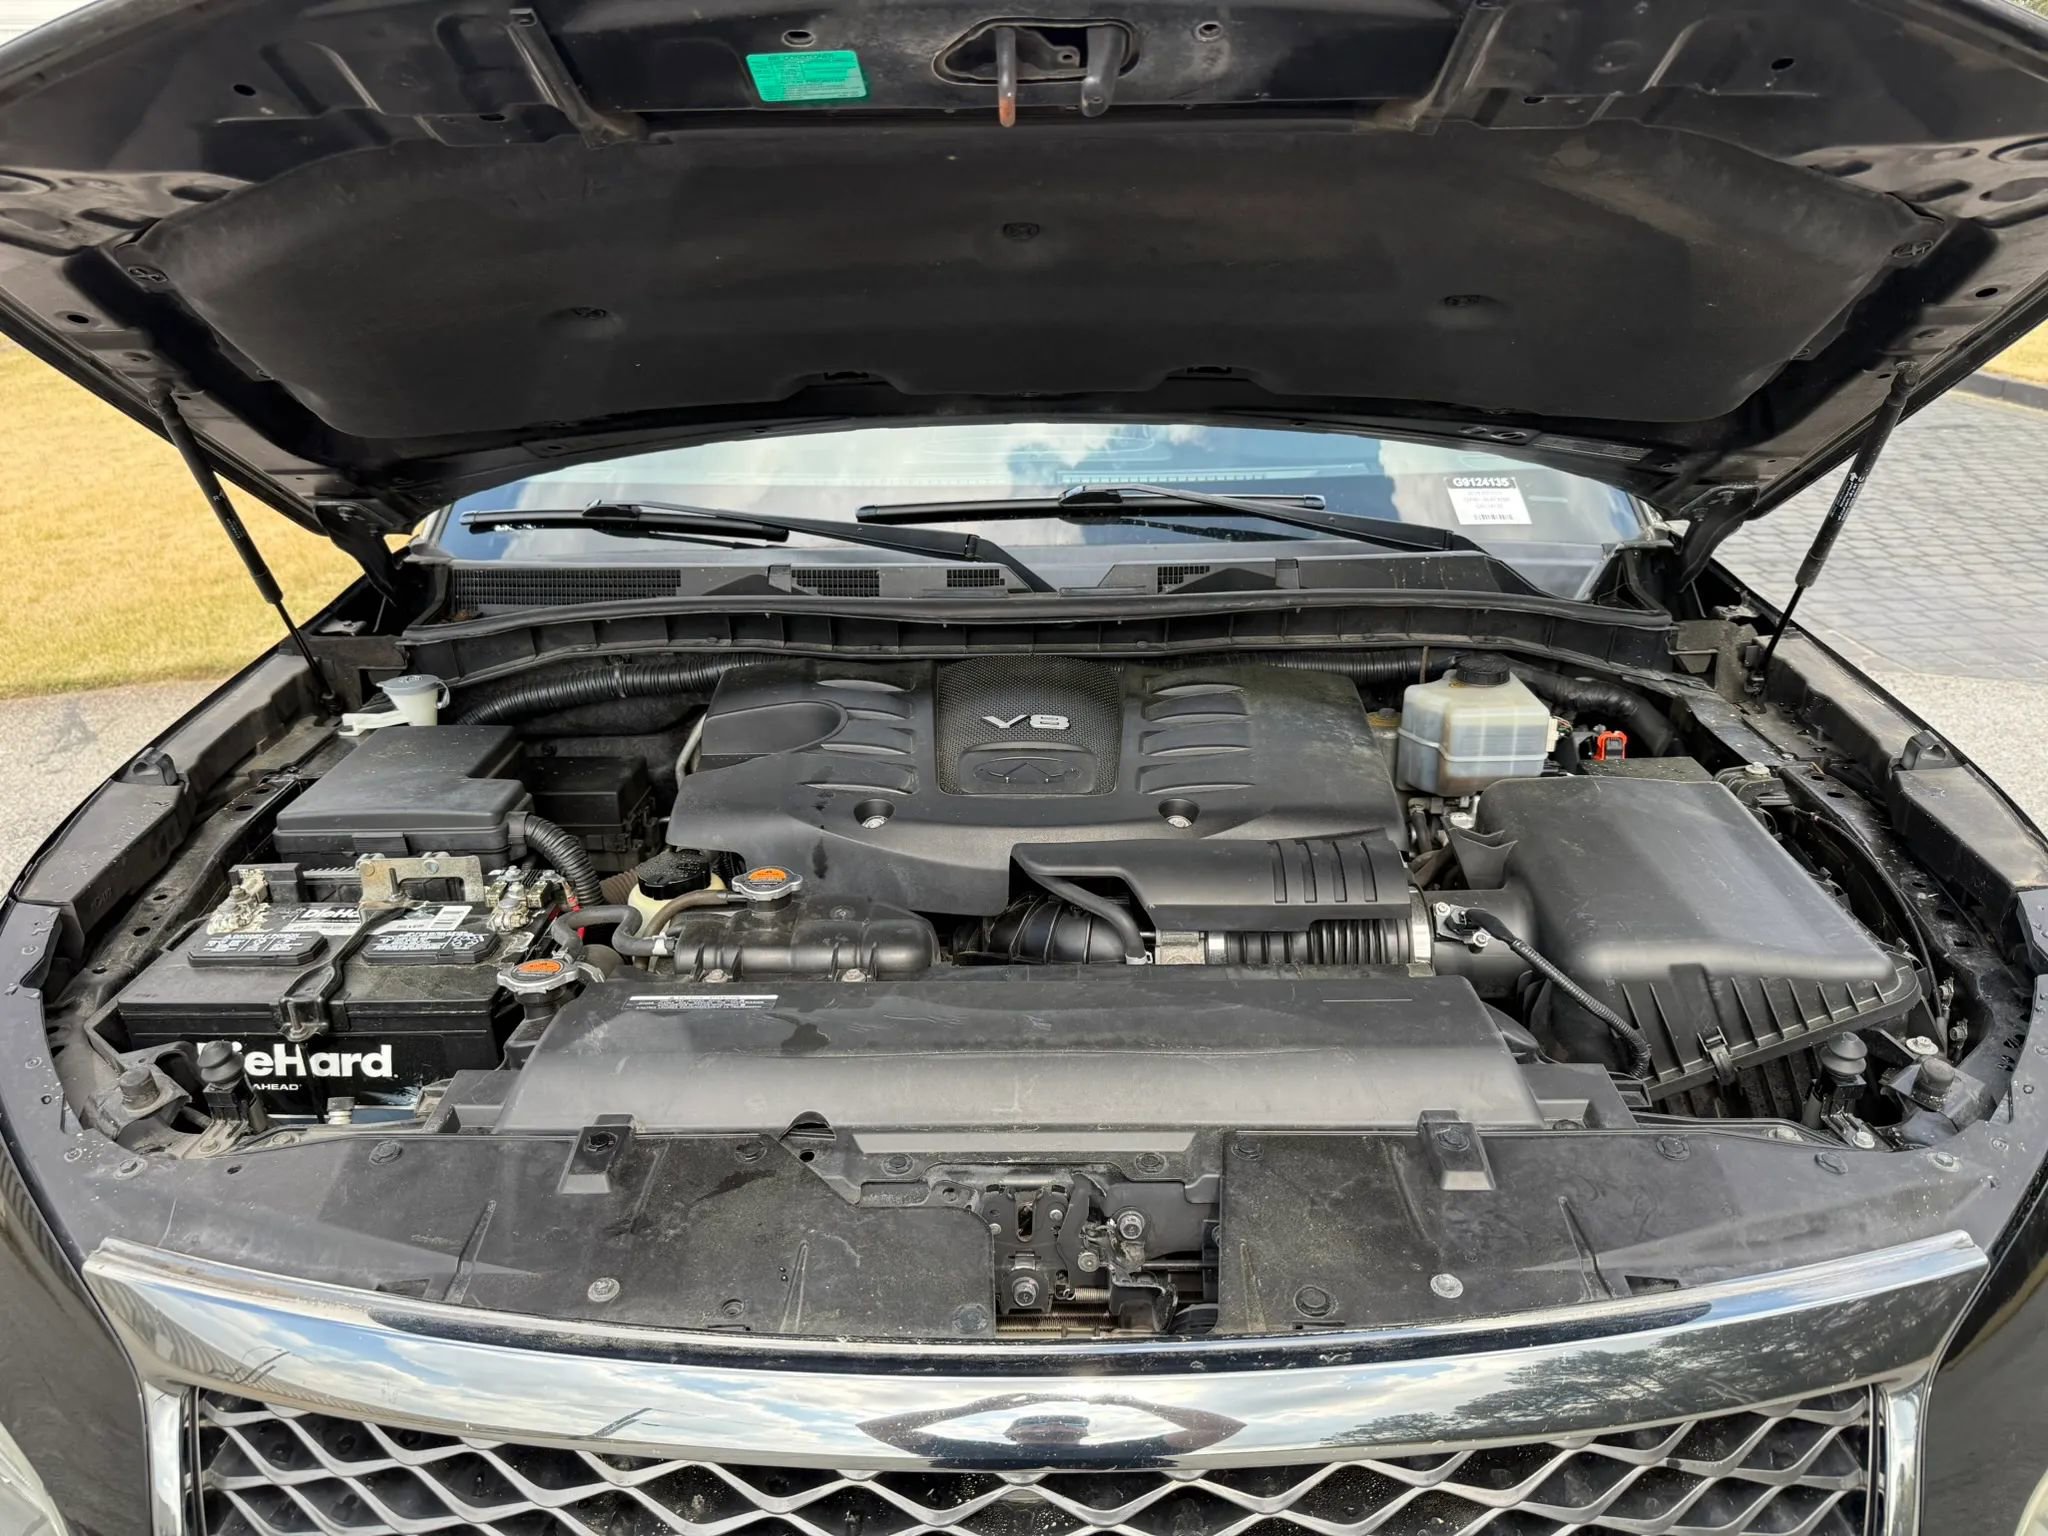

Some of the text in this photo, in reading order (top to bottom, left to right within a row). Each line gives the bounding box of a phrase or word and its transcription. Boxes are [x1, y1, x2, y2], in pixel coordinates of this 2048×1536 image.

[1452, 476, 1510, 488] G9124135
[981, 714, 1070, 730] V8
[196, 1041, 393, 1078] eHard
